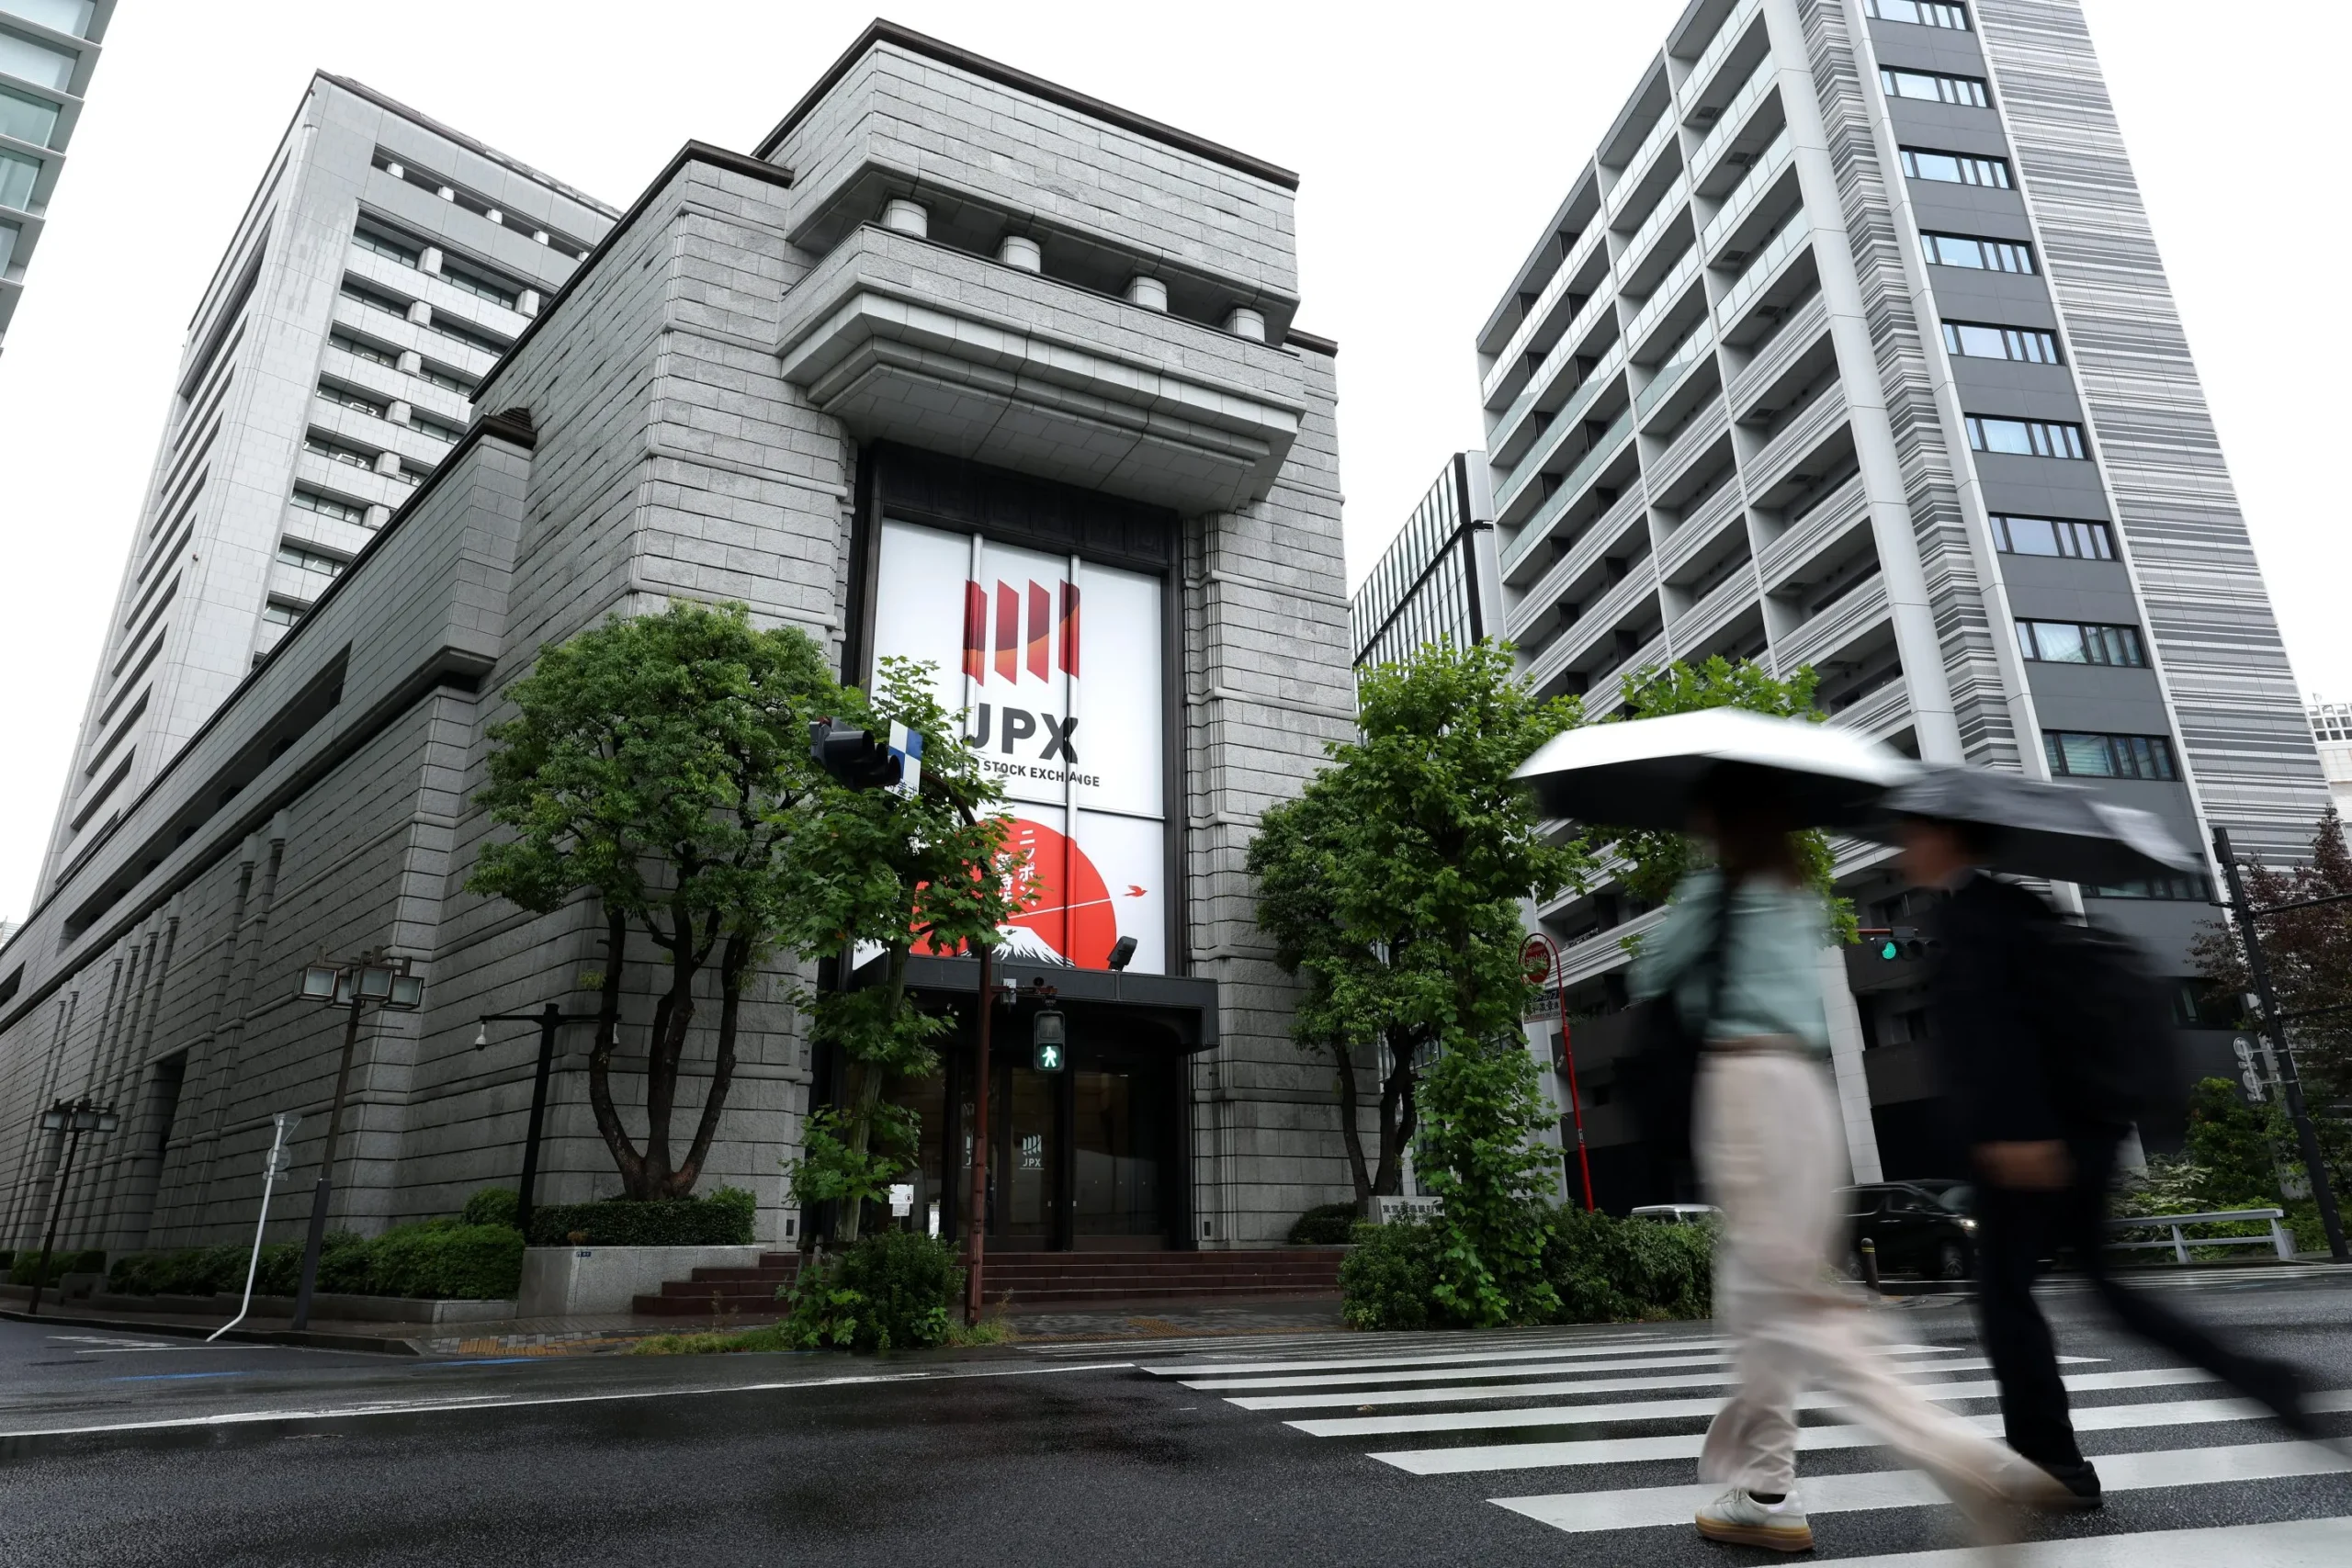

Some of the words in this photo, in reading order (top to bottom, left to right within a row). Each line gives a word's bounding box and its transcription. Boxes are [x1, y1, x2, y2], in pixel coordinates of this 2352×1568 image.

[960, 703, 1078, 764] JPX
[983, 761, 1026, 776] STOCK
[1030, 767, 1100, 787] EXCHANGE
[1023, 1158, 1041, 1167] JPX
